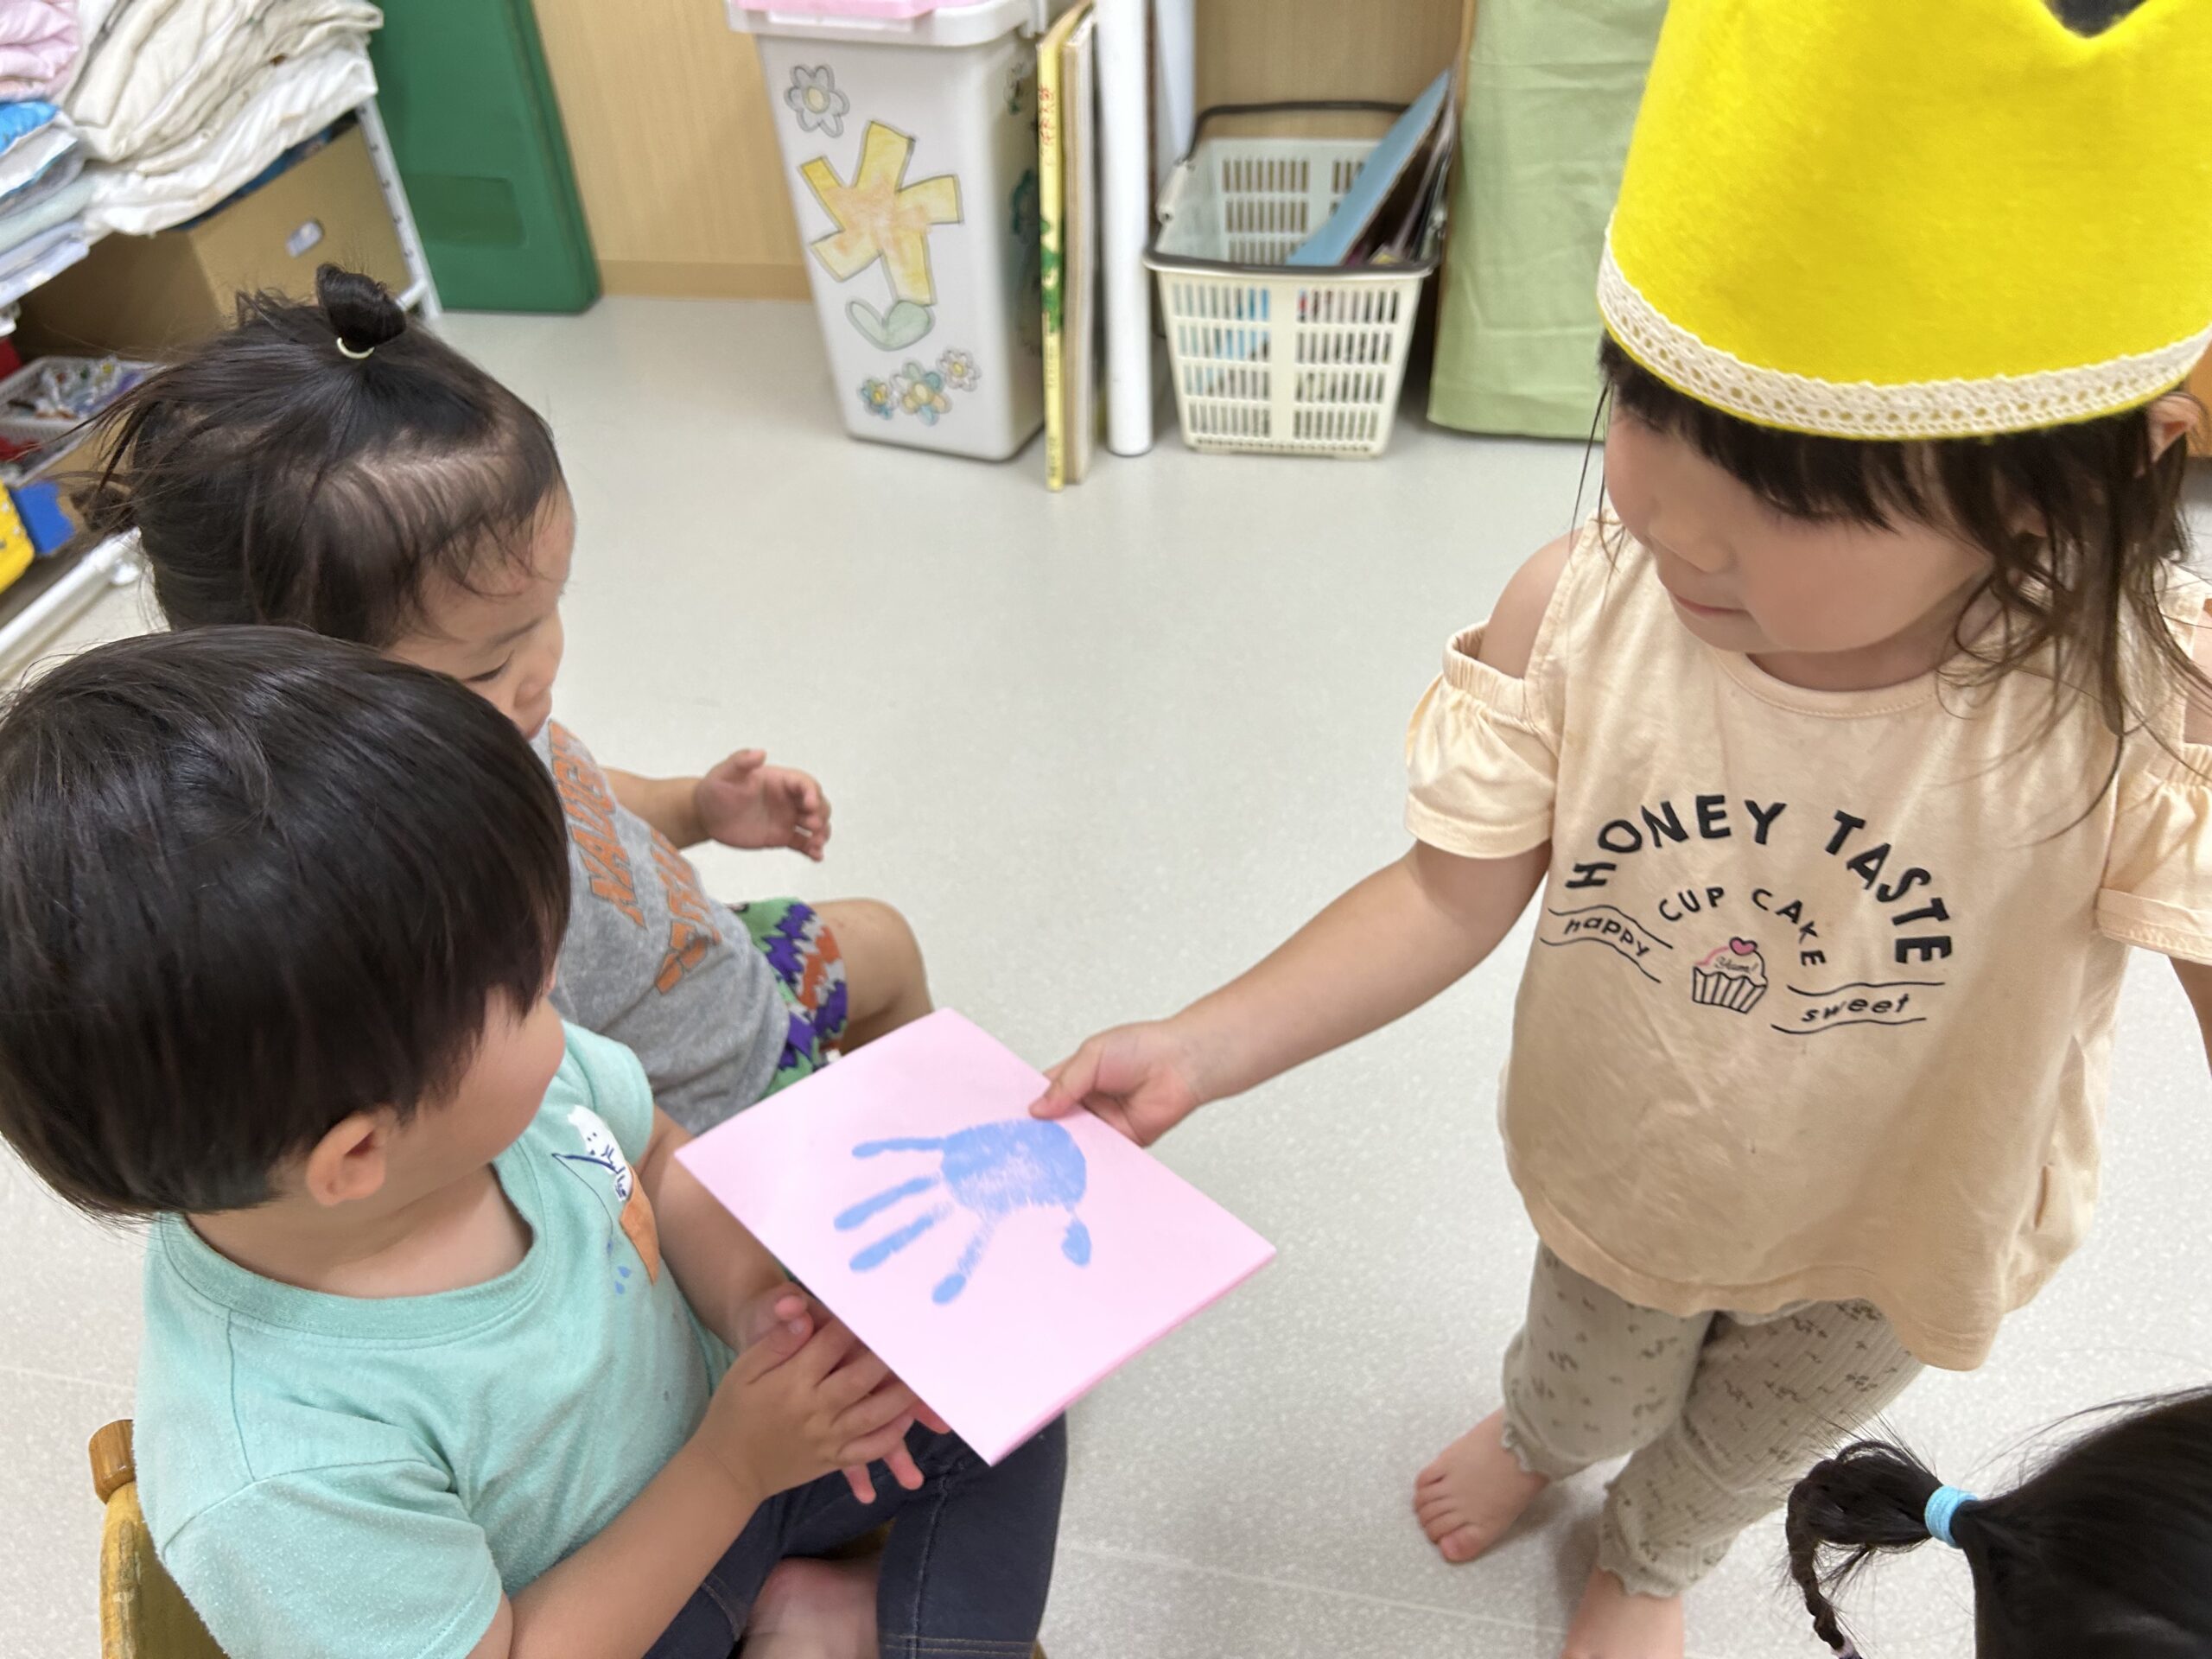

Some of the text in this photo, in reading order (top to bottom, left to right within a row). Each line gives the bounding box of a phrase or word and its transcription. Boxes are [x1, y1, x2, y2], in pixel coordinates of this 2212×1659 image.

[1565, 794, 1953, 964] HONEY TASTE
[1564, 917, 1650, 957] happy
[1658, 887, 1827, 967] CUP CAKE
[1802, 993, 1910, 1022] sweet
